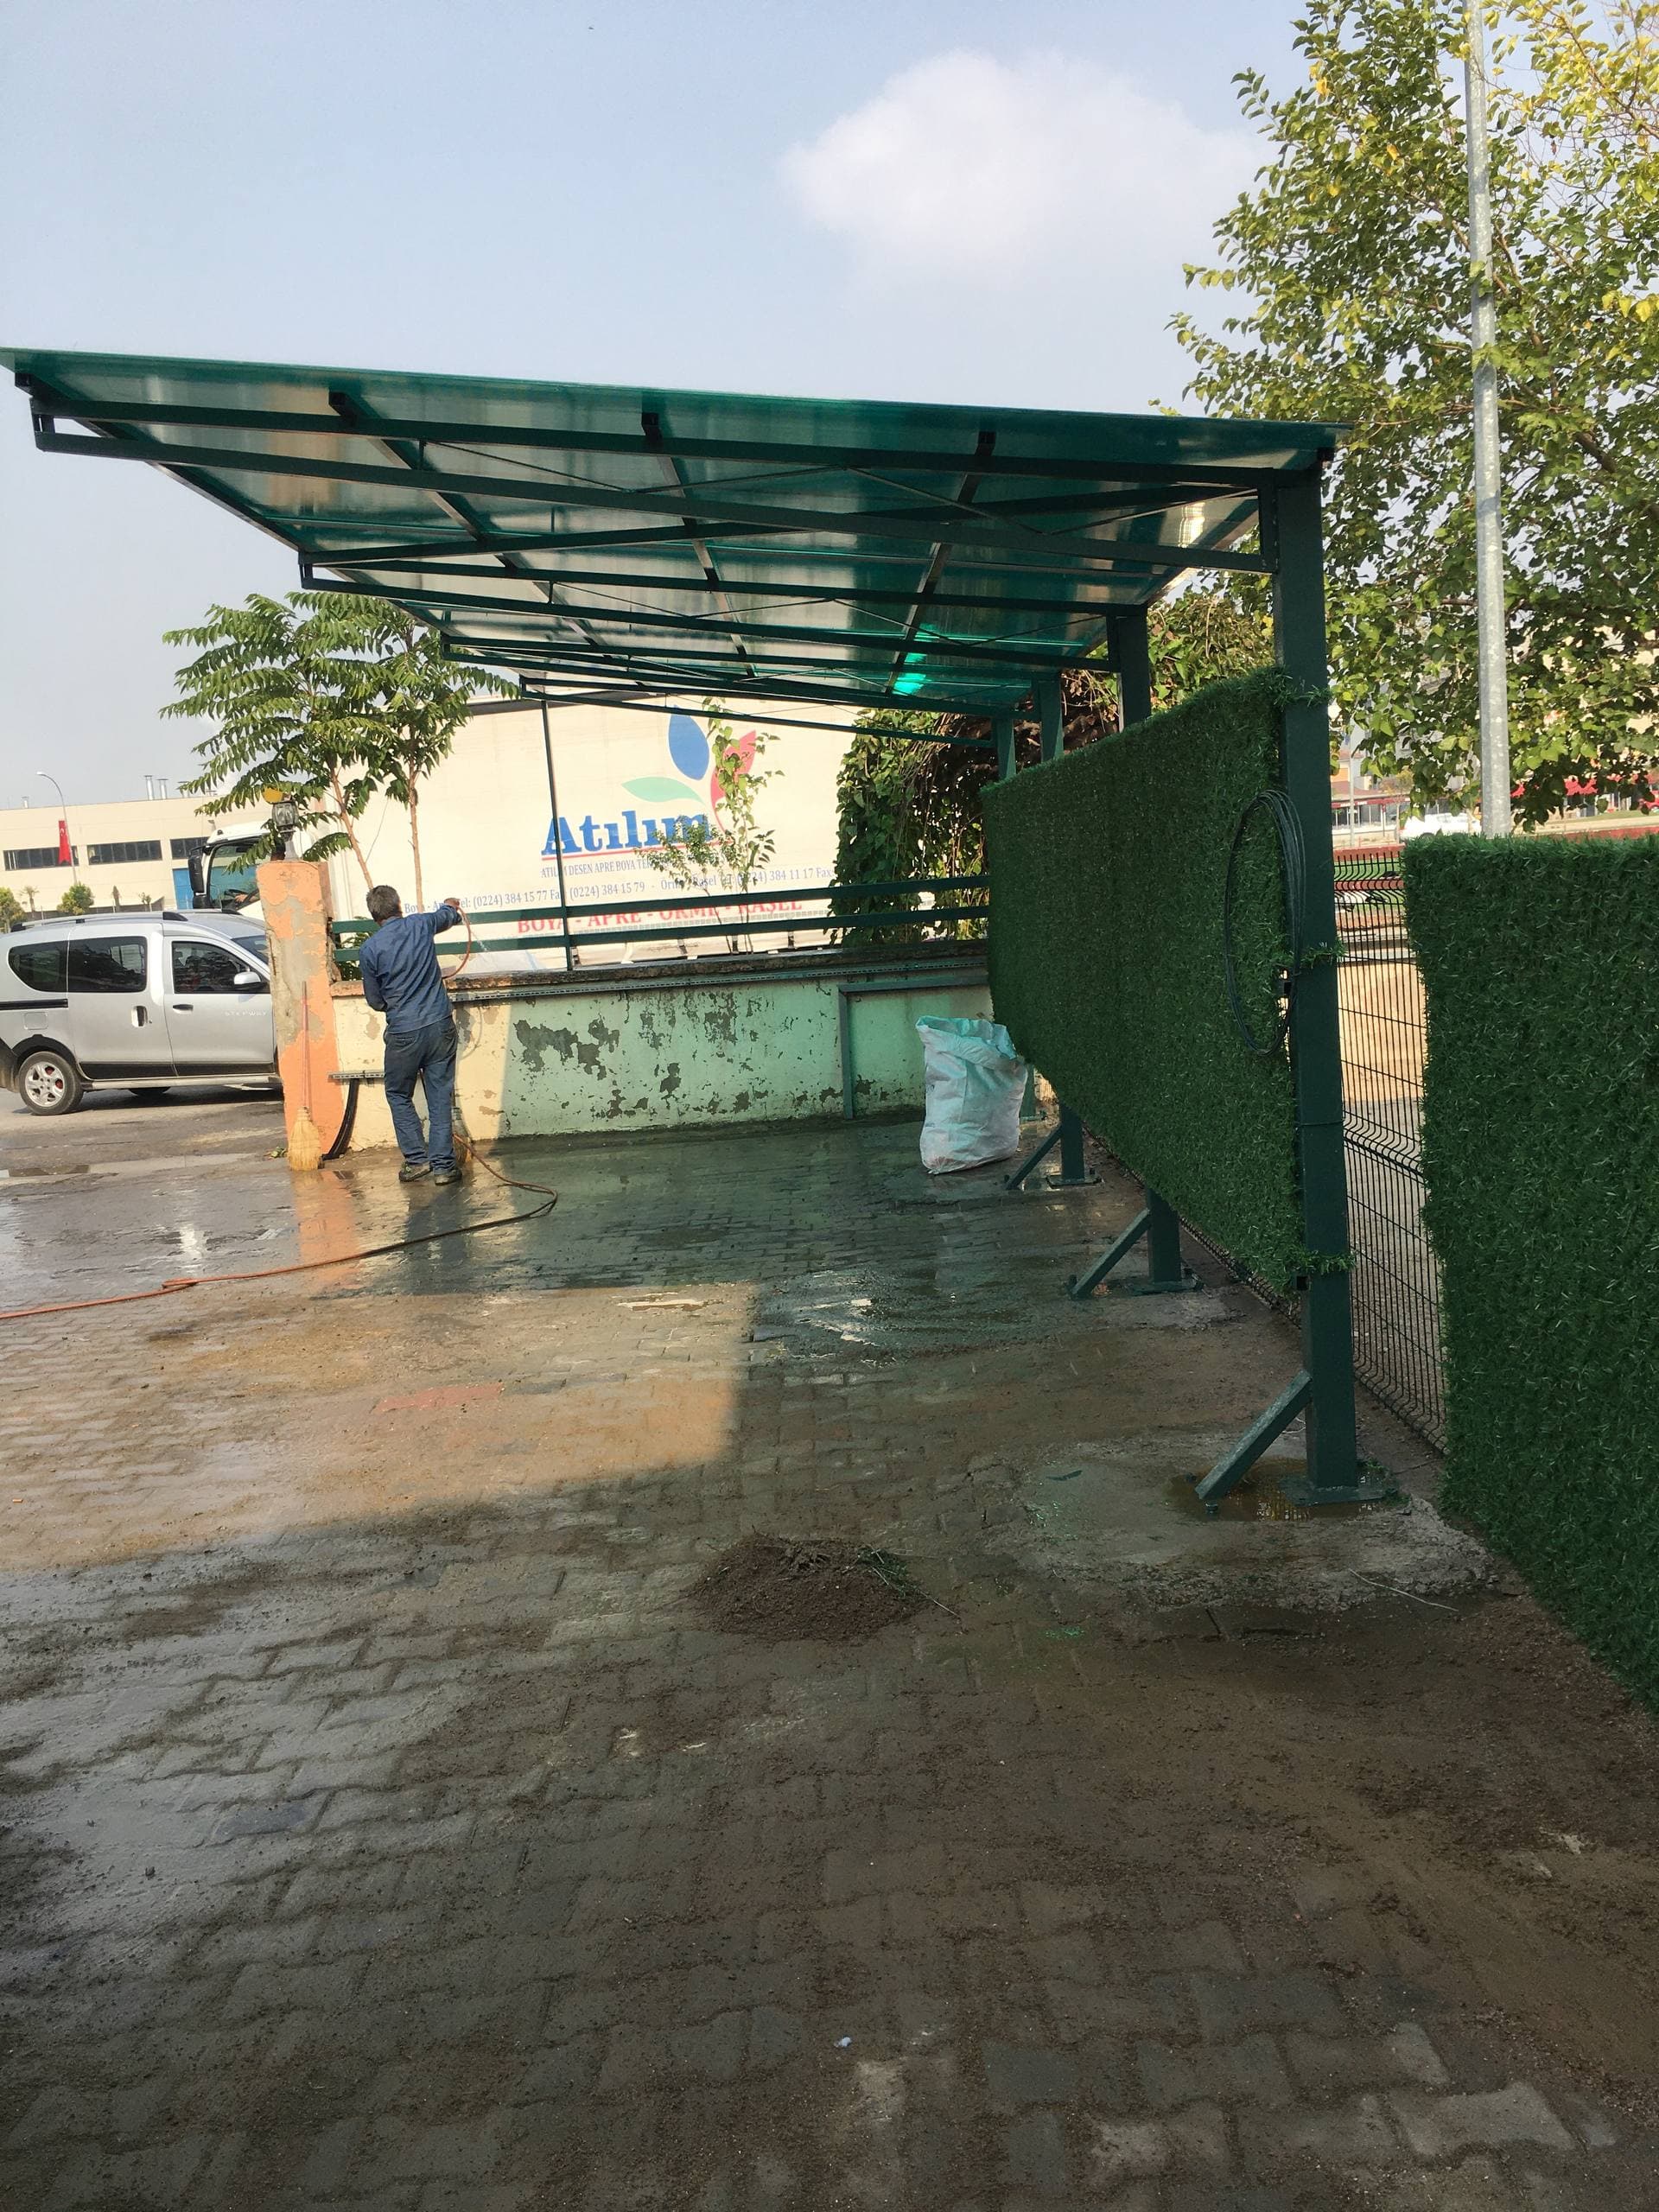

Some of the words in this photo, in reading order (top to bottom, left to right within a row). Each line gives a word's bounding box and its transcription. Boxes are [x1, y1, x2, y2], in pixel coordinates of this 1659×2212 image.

[569, 864, 594, 876] DESEN
[594, 861, 615, 874] APRE
[616, 860, 636, 871] BOYA
[473, 893, 503, 909] (0224)
[505, 893, 522, 906] 384
[524, 891, 536, 903] 15
[537, 890, 548, 901] 77
[569, 885, 600, 901] (0224)
[601, 884, 619, 896] 384
[621, 882, 632, 893] 15
[633, 881, 645, 893] 79
[769, 869, 786, 881] 384
[790, 868, 800, 880] 11
[802, 868, 813, 879] 17
